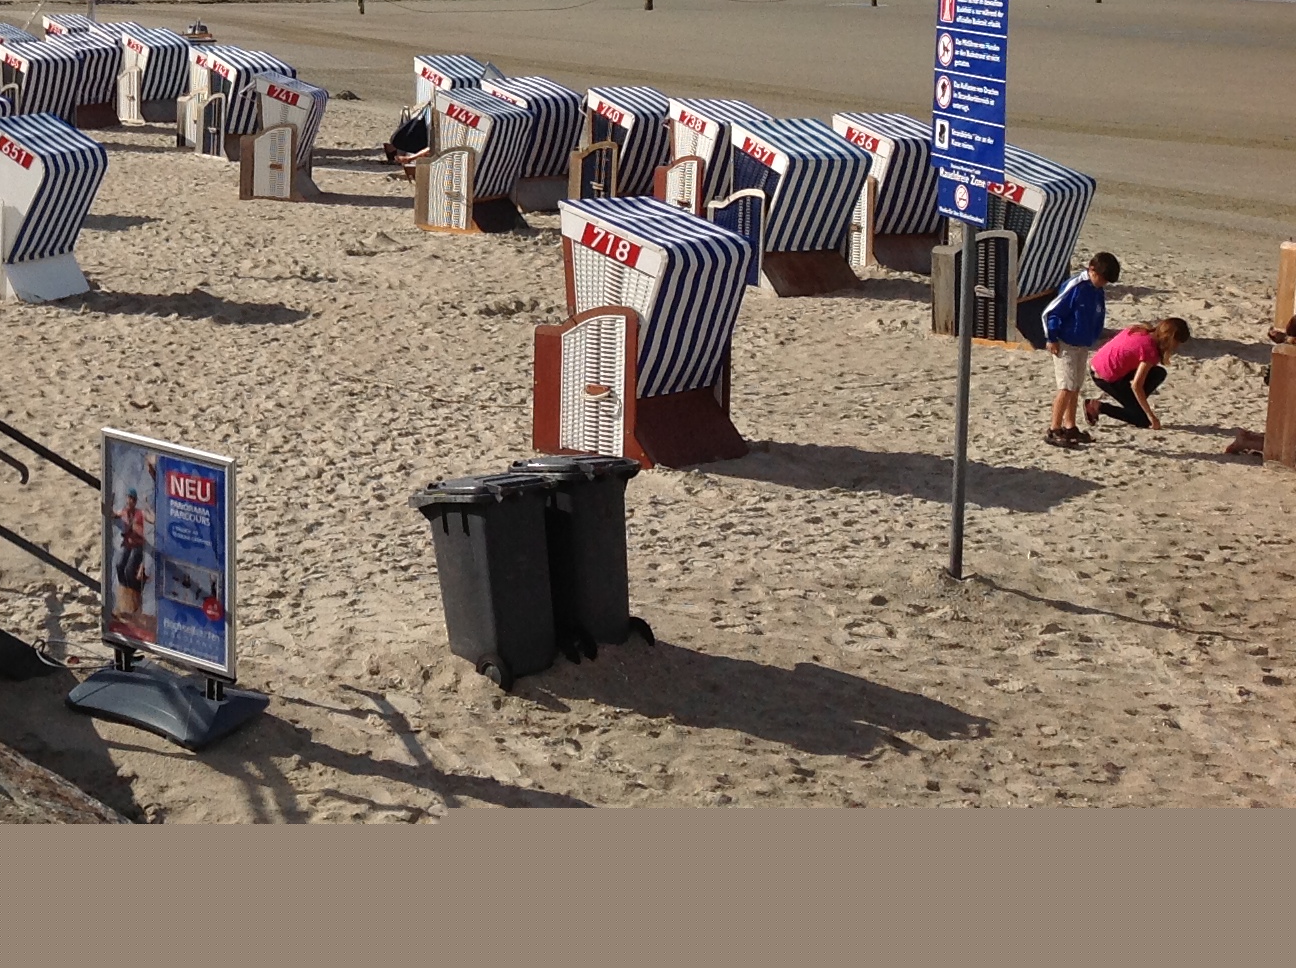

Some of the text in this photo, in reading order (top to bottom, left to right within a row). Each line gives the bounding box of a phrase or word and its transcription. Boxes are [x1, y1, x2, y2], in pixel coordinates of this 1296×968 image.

[272, 87, 294, 105] 741
[451, 106, 475, 122] 747
[600, 103, 620, 123] 740
[683, 112, 703, 132] 738
[849, 129, 873, 151] 736
[1, 141, 26, 165] 651
[747, 142, 772, 159] 757
[590, 226, 631, 262] 718
[170, 474, 211, 503] NEU
[169, 499, 211, 517] PANORAMA
[169, 508, 211, 527] PARCOURS
